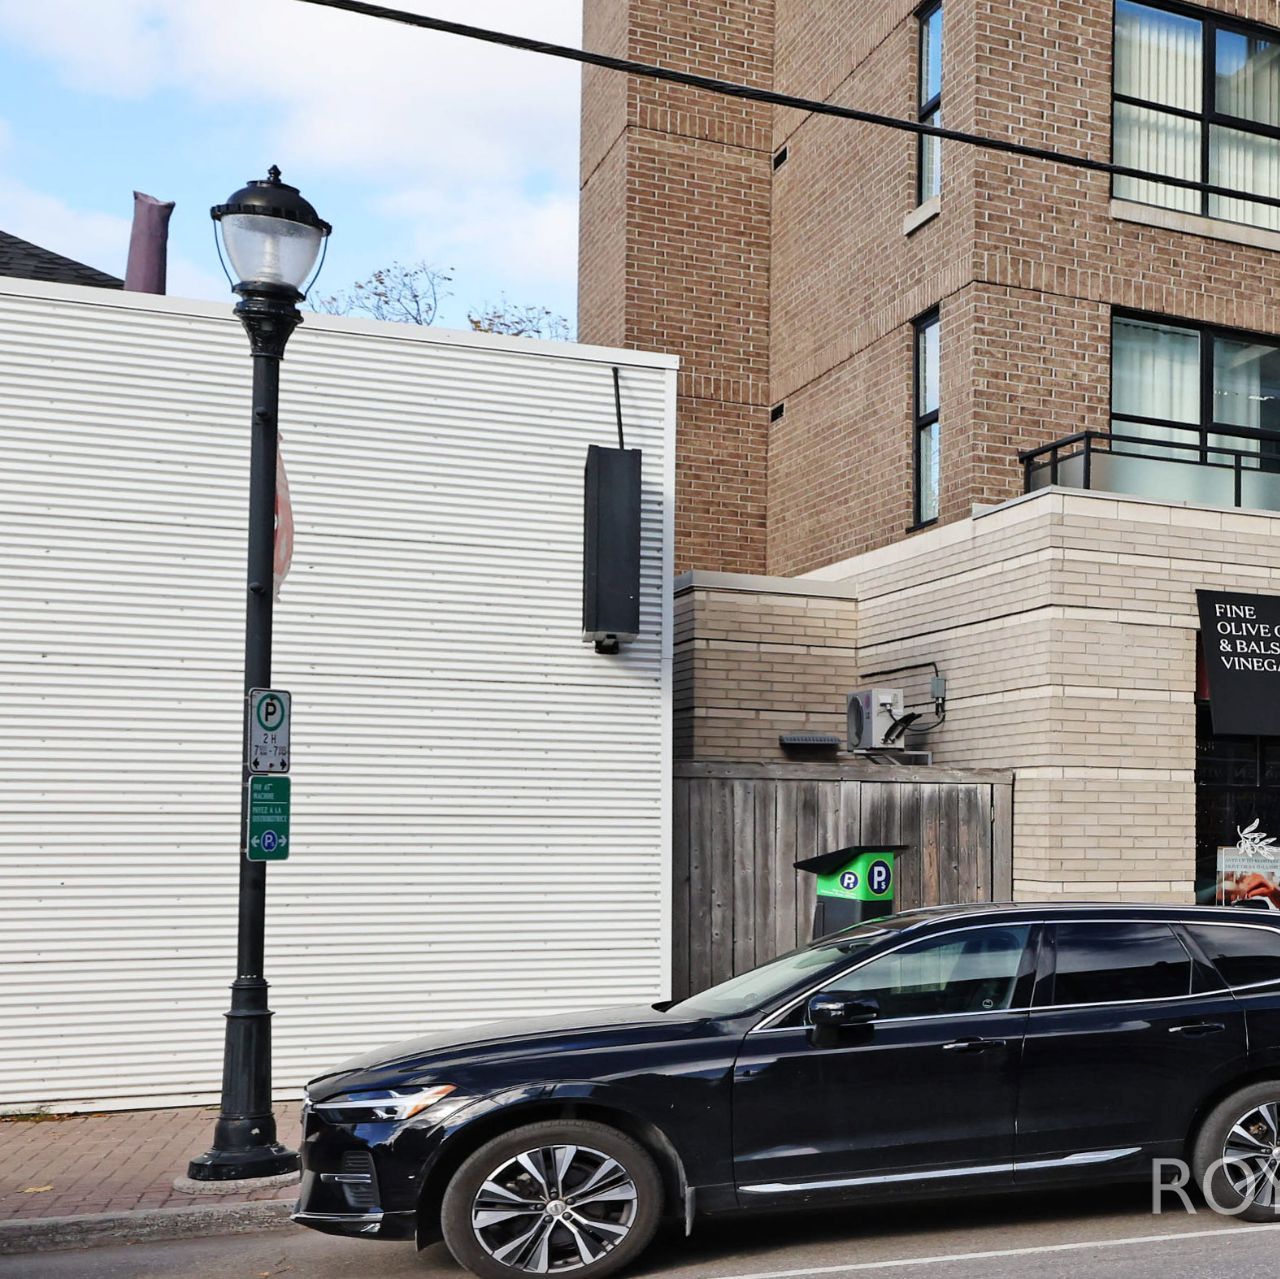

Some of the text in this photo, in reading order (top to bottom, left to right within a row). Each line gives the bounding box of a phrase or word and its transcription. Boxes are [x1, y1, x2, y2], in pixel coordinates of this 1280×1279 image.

[1215, 603, 1257, 619] FINE
[1217, 621, 1272, 638] OLIVE
[1219, 639, 1233, 653] &
[265, 701, 277, 722] P
